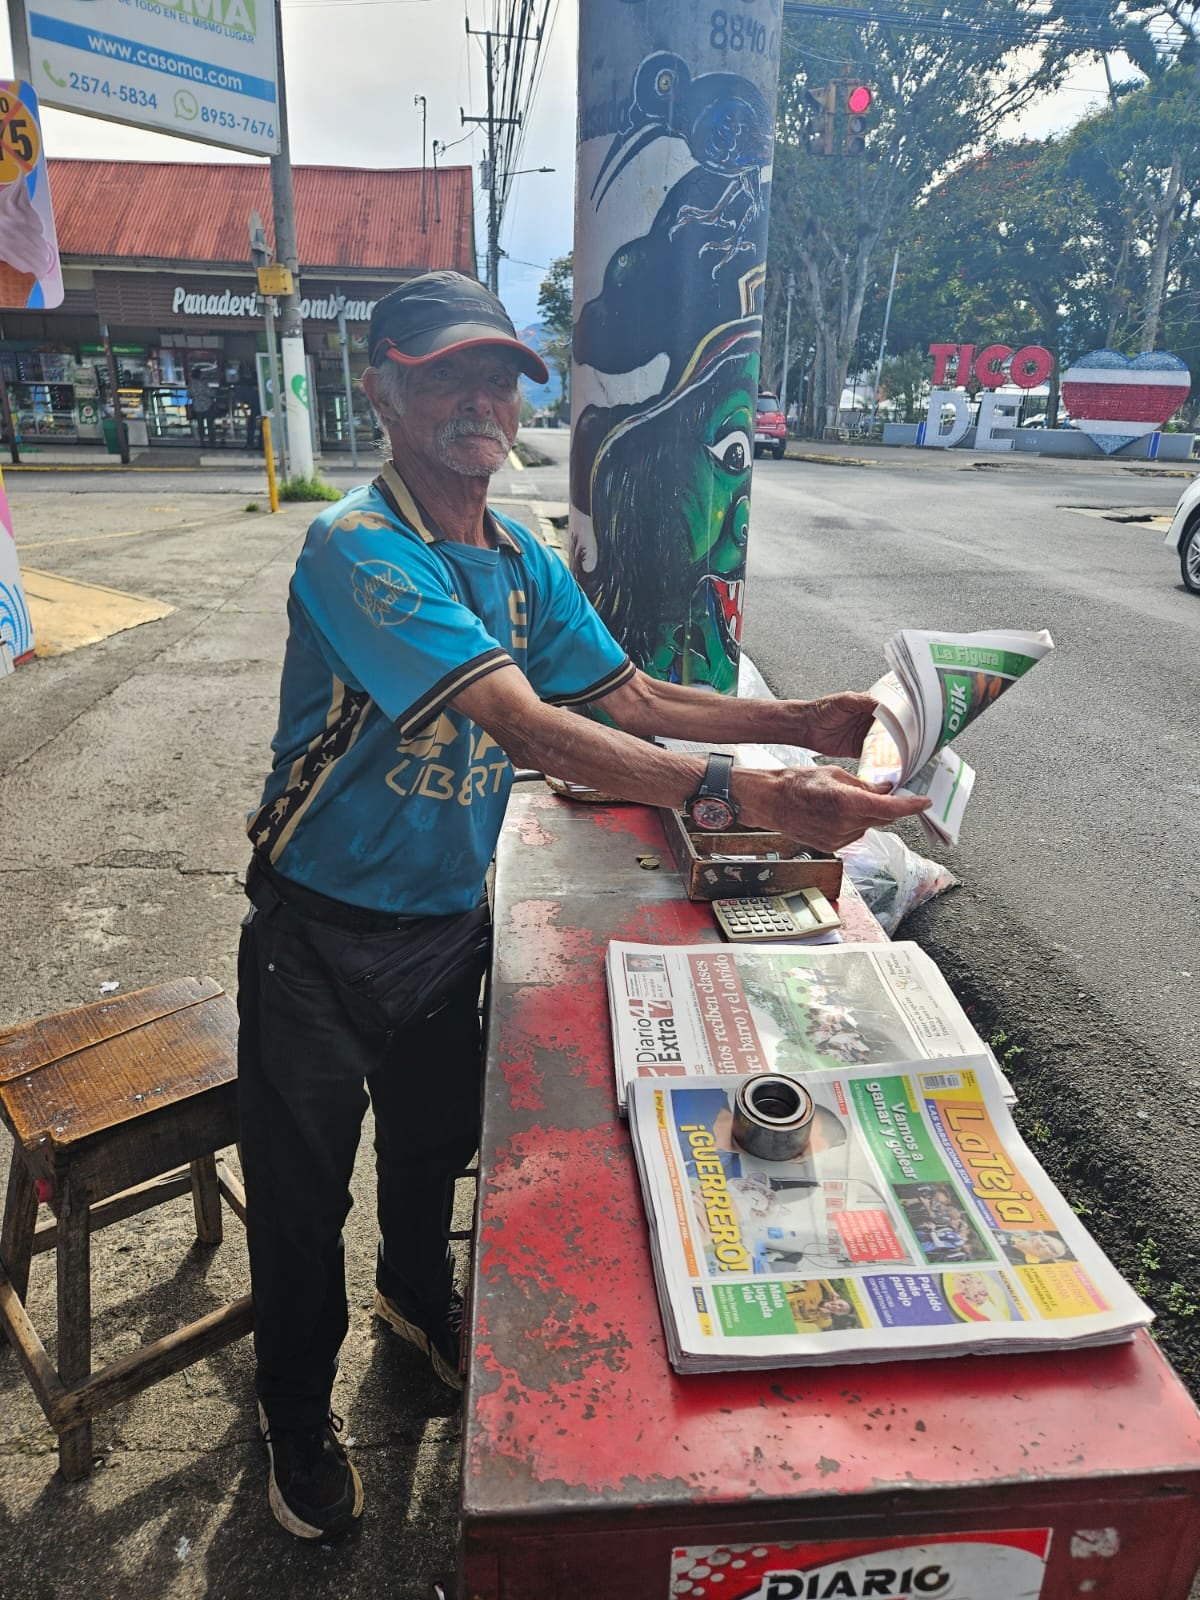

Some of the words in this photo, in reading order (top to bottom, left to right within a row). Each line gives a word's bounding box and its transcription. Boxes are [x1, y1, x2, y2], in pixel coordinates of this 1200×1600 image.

[135, 0, 161, 15] TODO
[164, 8, 176, 20] EN
[179, 13, 190, 24] EL
[192, 17, 222, 34] MISMO
[224, 26, 255, 45] LUGAR
[163, 0, 256, 34] MA
[88, 34, 243, 92] www.casoma.com
[68, 71, 158, 110] 2574-5834
[201, 106, 275, 138] 8953-7676
[172, 286, 279, 317] Panaderi
[928, 343, 1054, 388] TICO
[921, 390, 1023, 450] DE
[934, 645, 953, 660] La
[956, 648, 999, 666] Figura
[948, 682, 967, 732] Dijk
[696, 960, 714, 994] clases
[713, 953, 737, 990] olvido
[727, 989, 740, 1004] el
[733, 1005, 749, 1016] y
[704, 995, 728, 1043] reciben
[738, 1015, 756, 1053] barro
[633, 1018, 657, 1063] Diario
[657, 1018, 681, 1062] Extra
[717, 1043, 736, 1075] iños
[746, 1055, 763, 1075] tre
[866, 1082, 892, 1128] ganar
[885, 1128, 898, 1138] y
[891, 1102, 919, 1152] Vamos
[912, 1152, 923, 1162] a
[927, 1105, 938, 1122] LAS
[935, 1122, 950, 1148] VARAS
[946, 1148, 961, 1167] COMO
[957, 1168, 971, 1185] SON
[886, 1139, 918, 1180] golear
[680, 1124, 749, 1273] ¡GUERRERO!
[741, 1285, 756, 1303] vial
[752, 1284, 774, 1319] jugada
[768, 1284, 784, 1308] Mala
[888, 1275, 911, 1308] parejo
[904, 1275, 920, 1297] más
[917, 1276, 942, 1312] Partido
[766, 1565, 950, 1600] DIARIO
